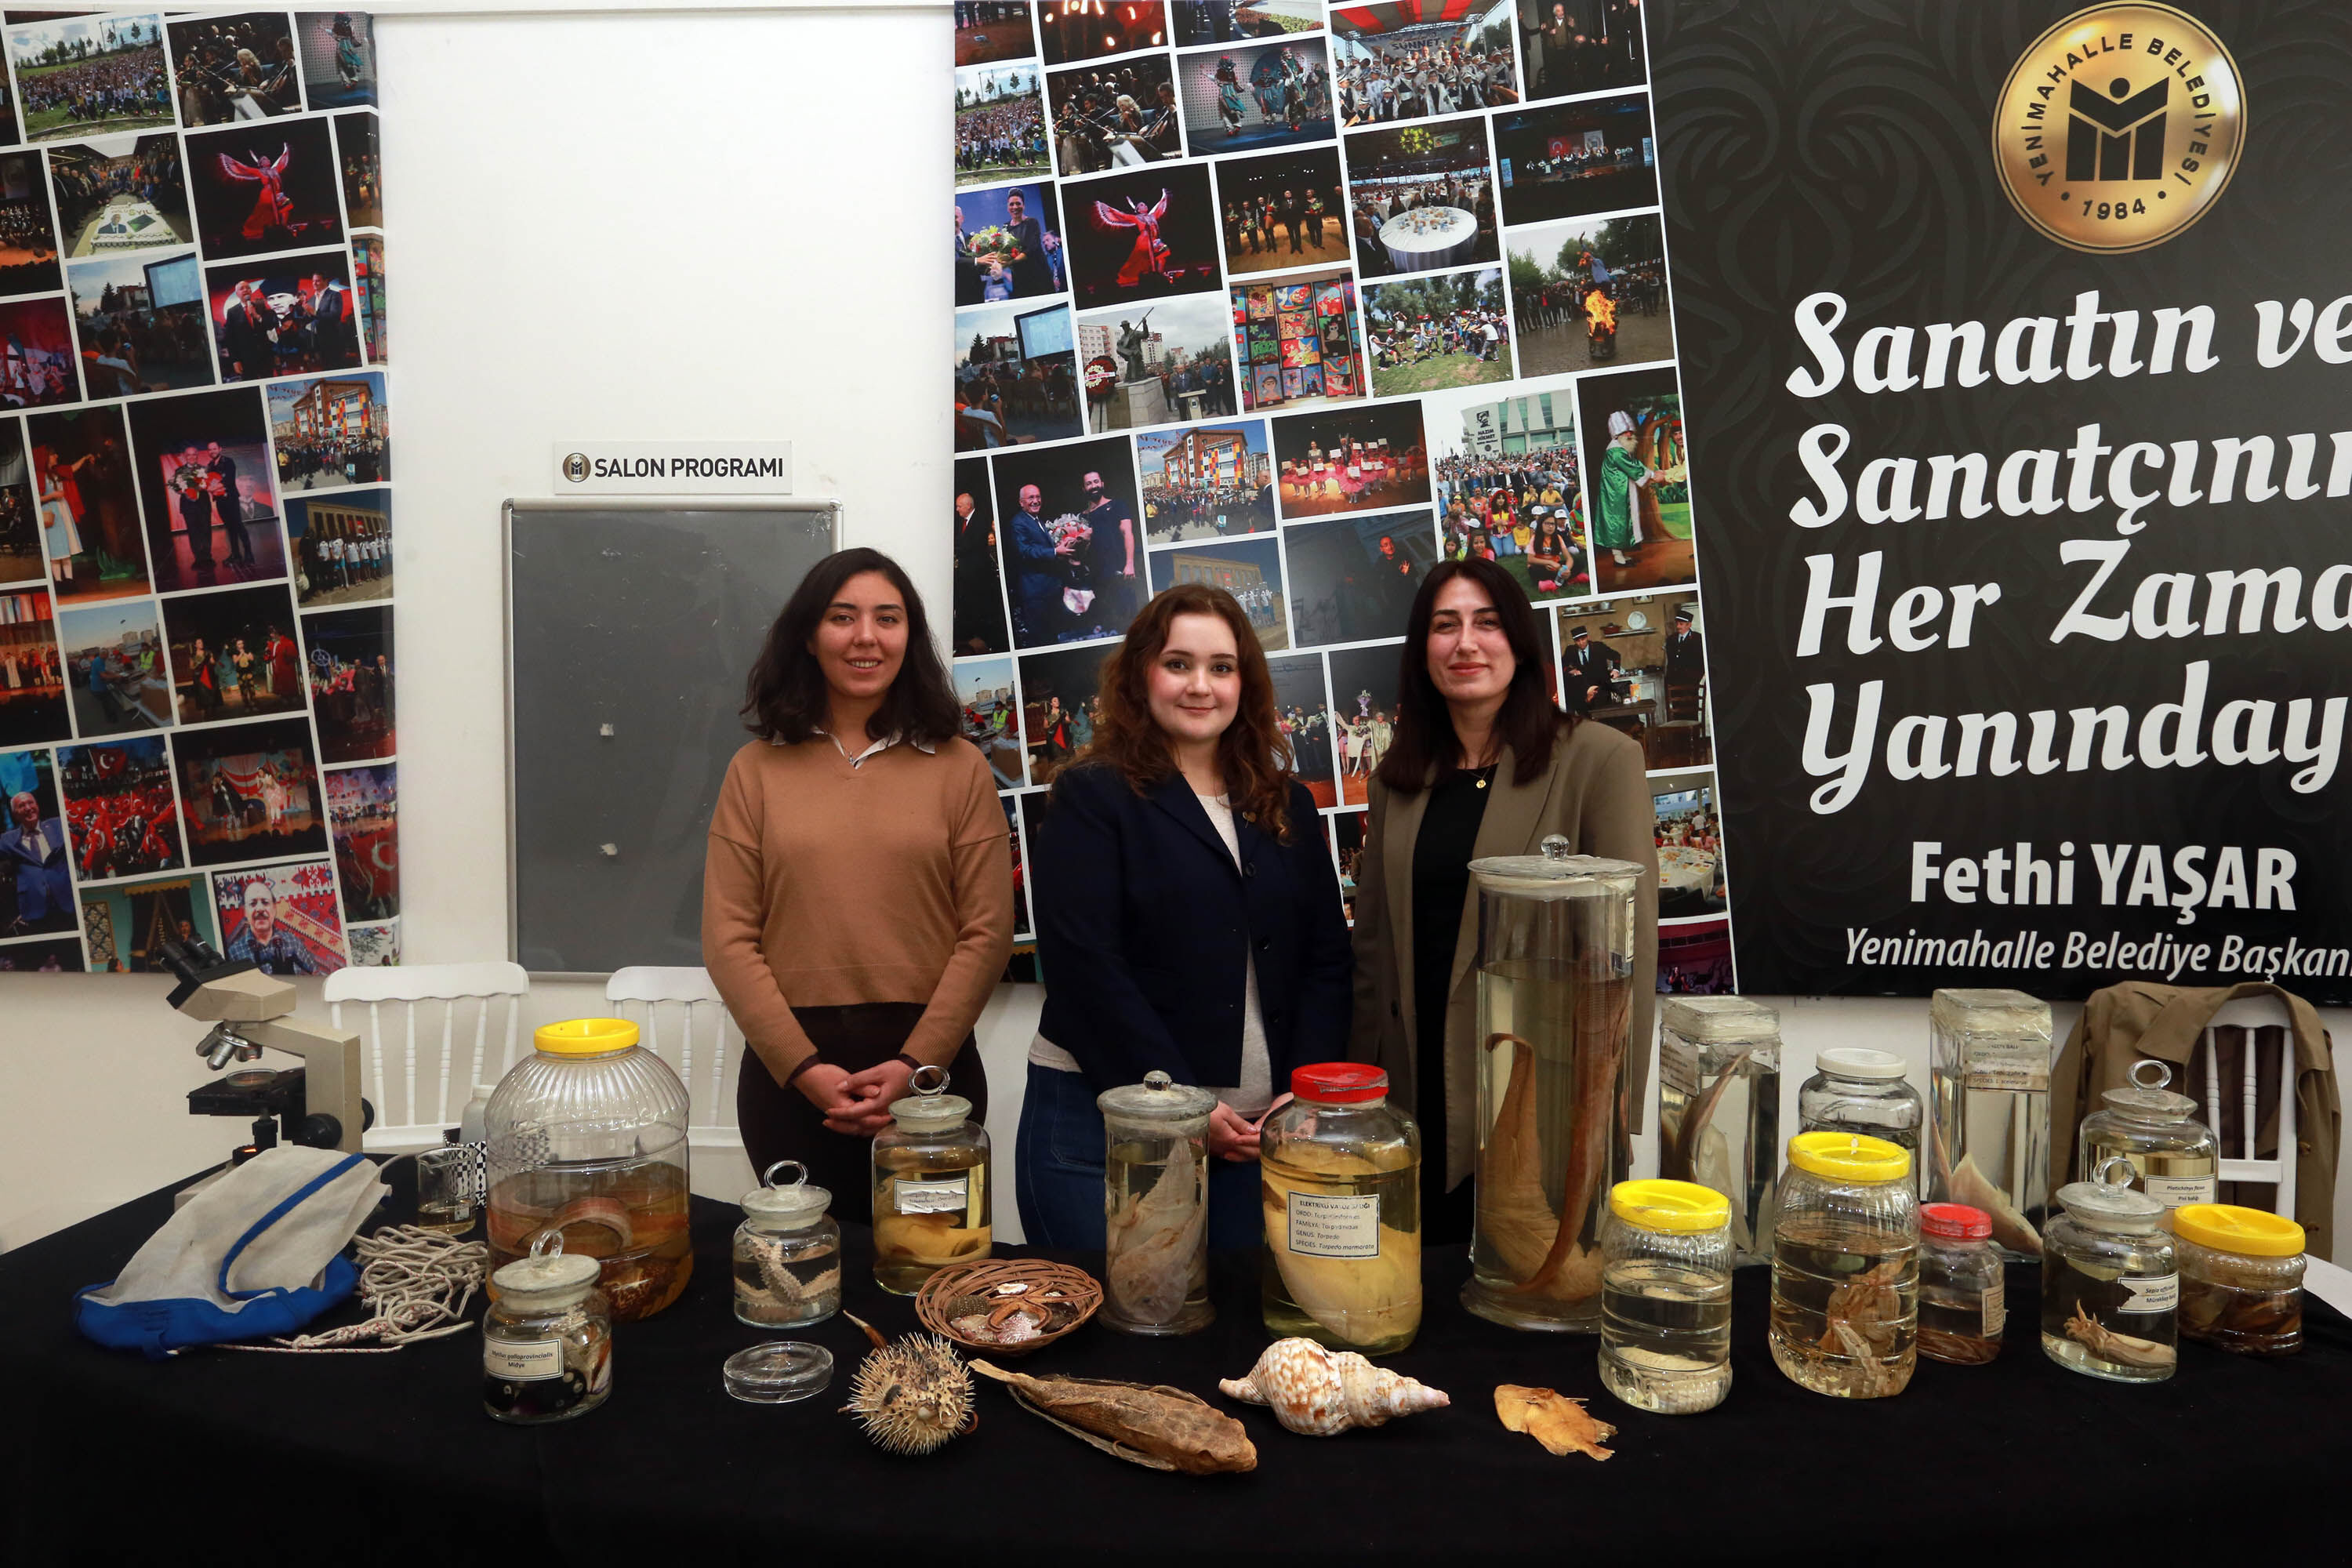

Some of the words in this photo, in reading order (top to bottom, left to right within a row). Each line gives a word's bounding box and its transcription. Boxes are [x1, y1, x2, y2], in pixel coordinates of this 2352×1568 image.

[2082, 198, 2146, 220] 1984
[1785, 289, 2220, 398] Sanatın
[2254, 294, 2352, 368] ve
[594, 458, 665, 477] SALON
[671, 458, 783, 477] PROGRAMI
[1796, 550, 2002, 657] Her
[1802, 659, 2349, 815] Yanınday
[1911, 841, 2074, 905] Fethi
[2090, 844, 2296, 925] YAŞAR
[1846, 927, 2055, 969] Yenimahalle
[2062, 931, 2211, 982] Belediye
[2218, 935, 2352, 984] Başkan
